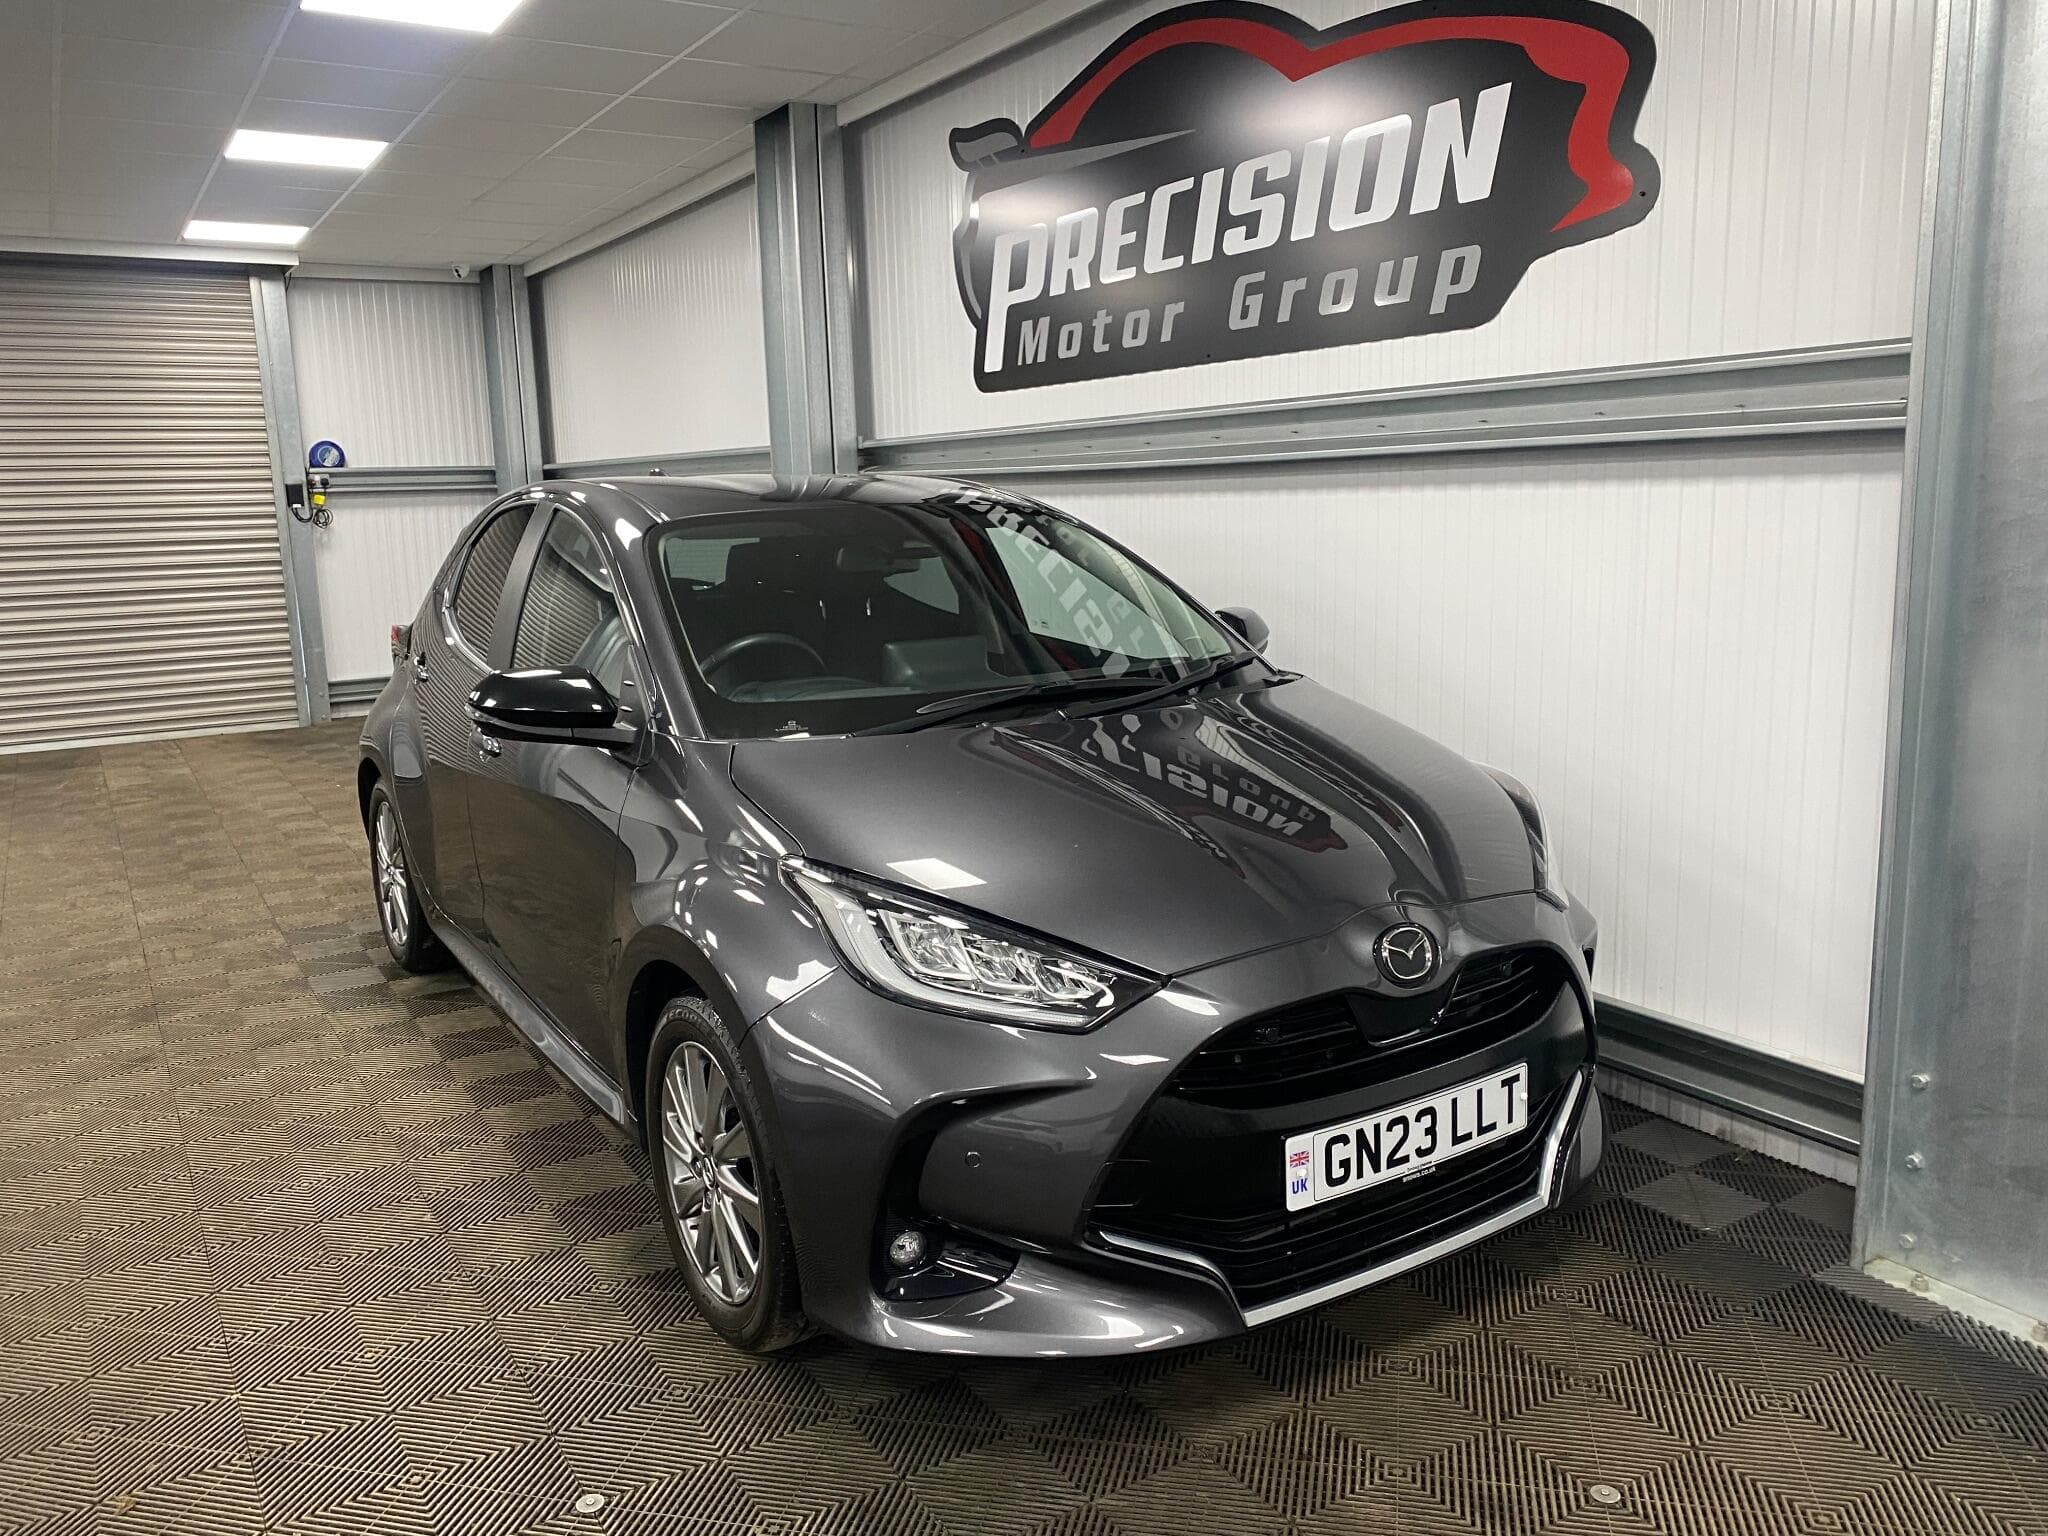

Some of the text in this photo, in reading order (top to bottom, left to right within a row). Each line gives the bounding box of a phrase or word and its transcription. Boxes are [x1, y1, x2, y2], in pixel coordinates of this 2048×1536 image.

[983, 82, 1513, 373] PRECISION
[1017, 244, 1483, 367] Motor Group
[1291, 1178, 1308, 1195] UK
[1324, 1073, 1521, 1188] GN23 LLT
